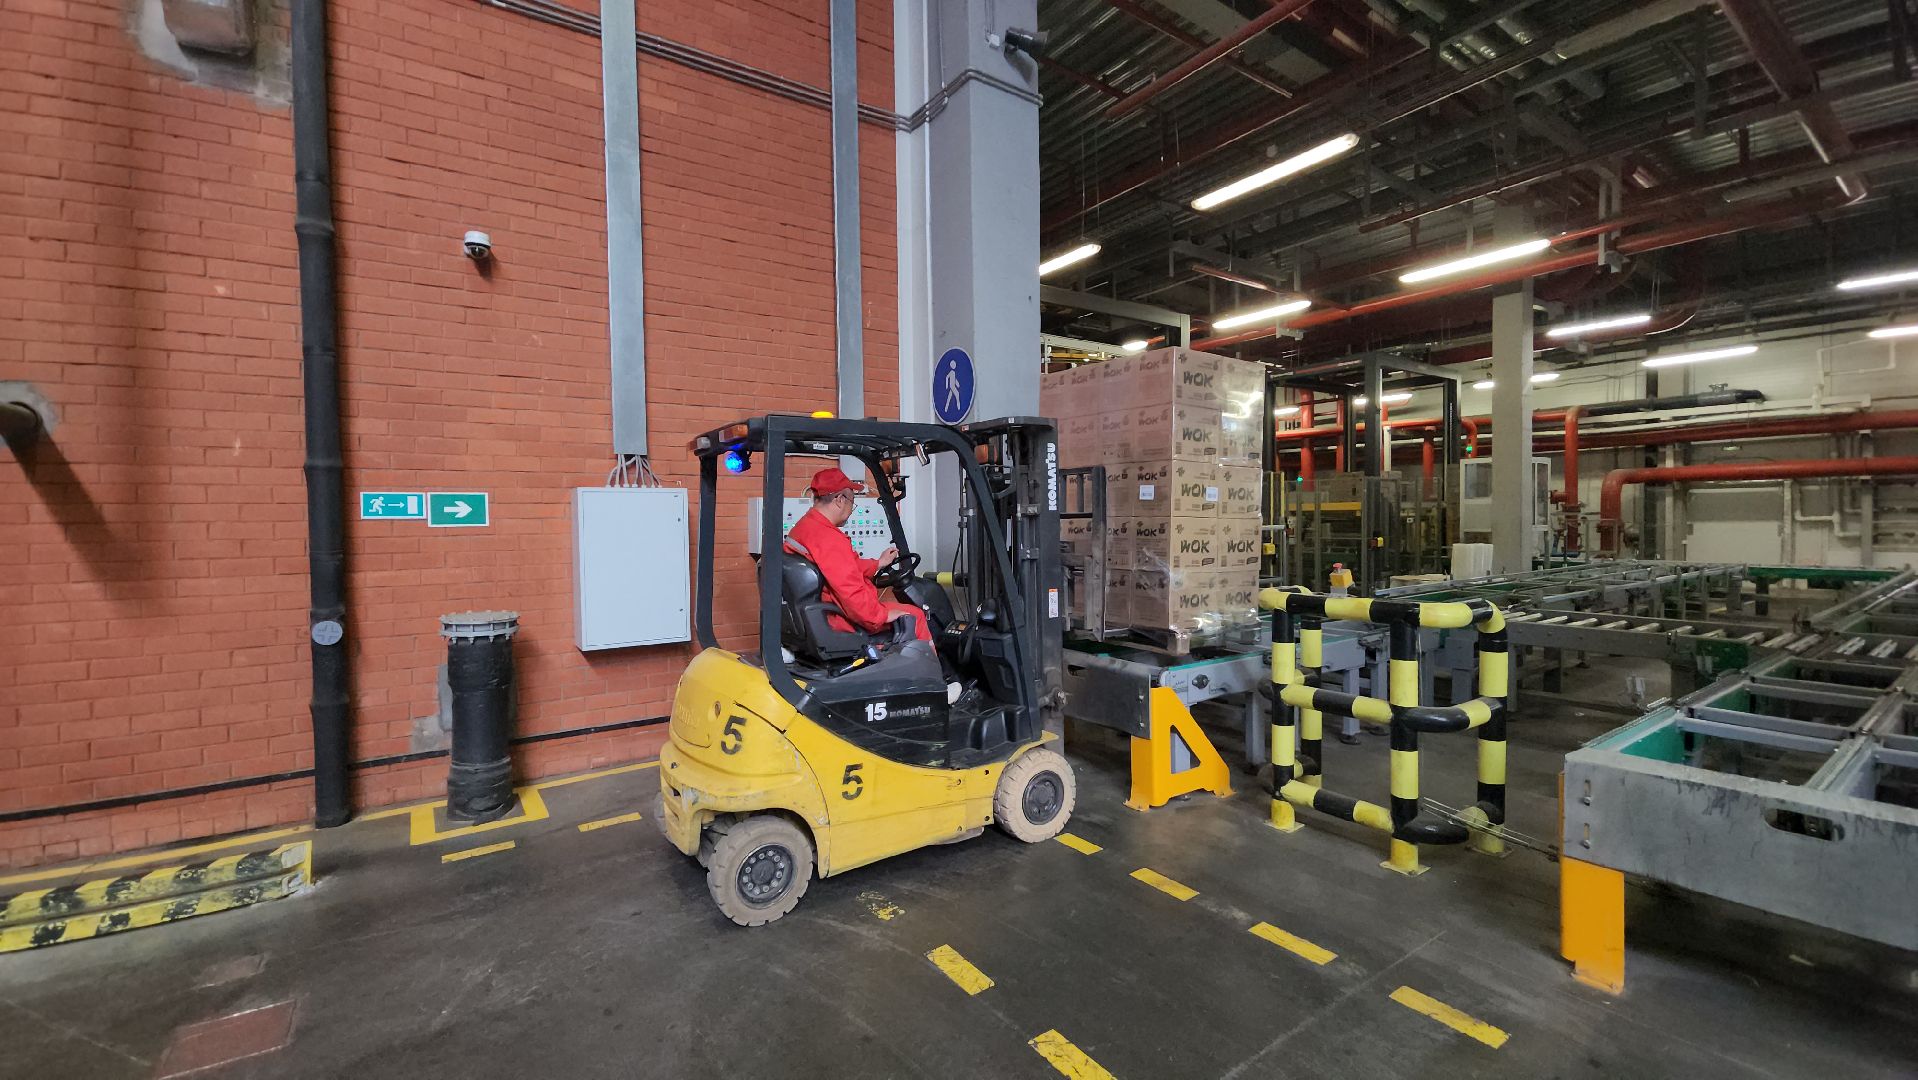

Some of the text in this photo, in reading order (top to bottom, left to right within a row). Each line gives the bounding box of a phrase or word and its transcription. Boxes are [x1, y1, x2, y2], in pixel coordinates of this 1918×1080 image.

[1183, 371, 1214, 388] WOK
[1182, 427, 1212, 442] WOK
[1046, 442, 1057, 511] KOMATSU
[1137, 472, 1158, 481] WOK
[1228, 487, 1254, 500] WOK
[1068, 527, 1085, 535] WOK
[1136, 527, 1157, 537] WOK
[1180, 540, 1210, 553] WOK
[1227, 540, 1255, 553] WOK
[1180, 594, 1210, 608] WOK
[865, 702, 931, 722] 15 KOMATSU
[721, 715, 747, 755] 5
[842, 763, 864, 801] 5
